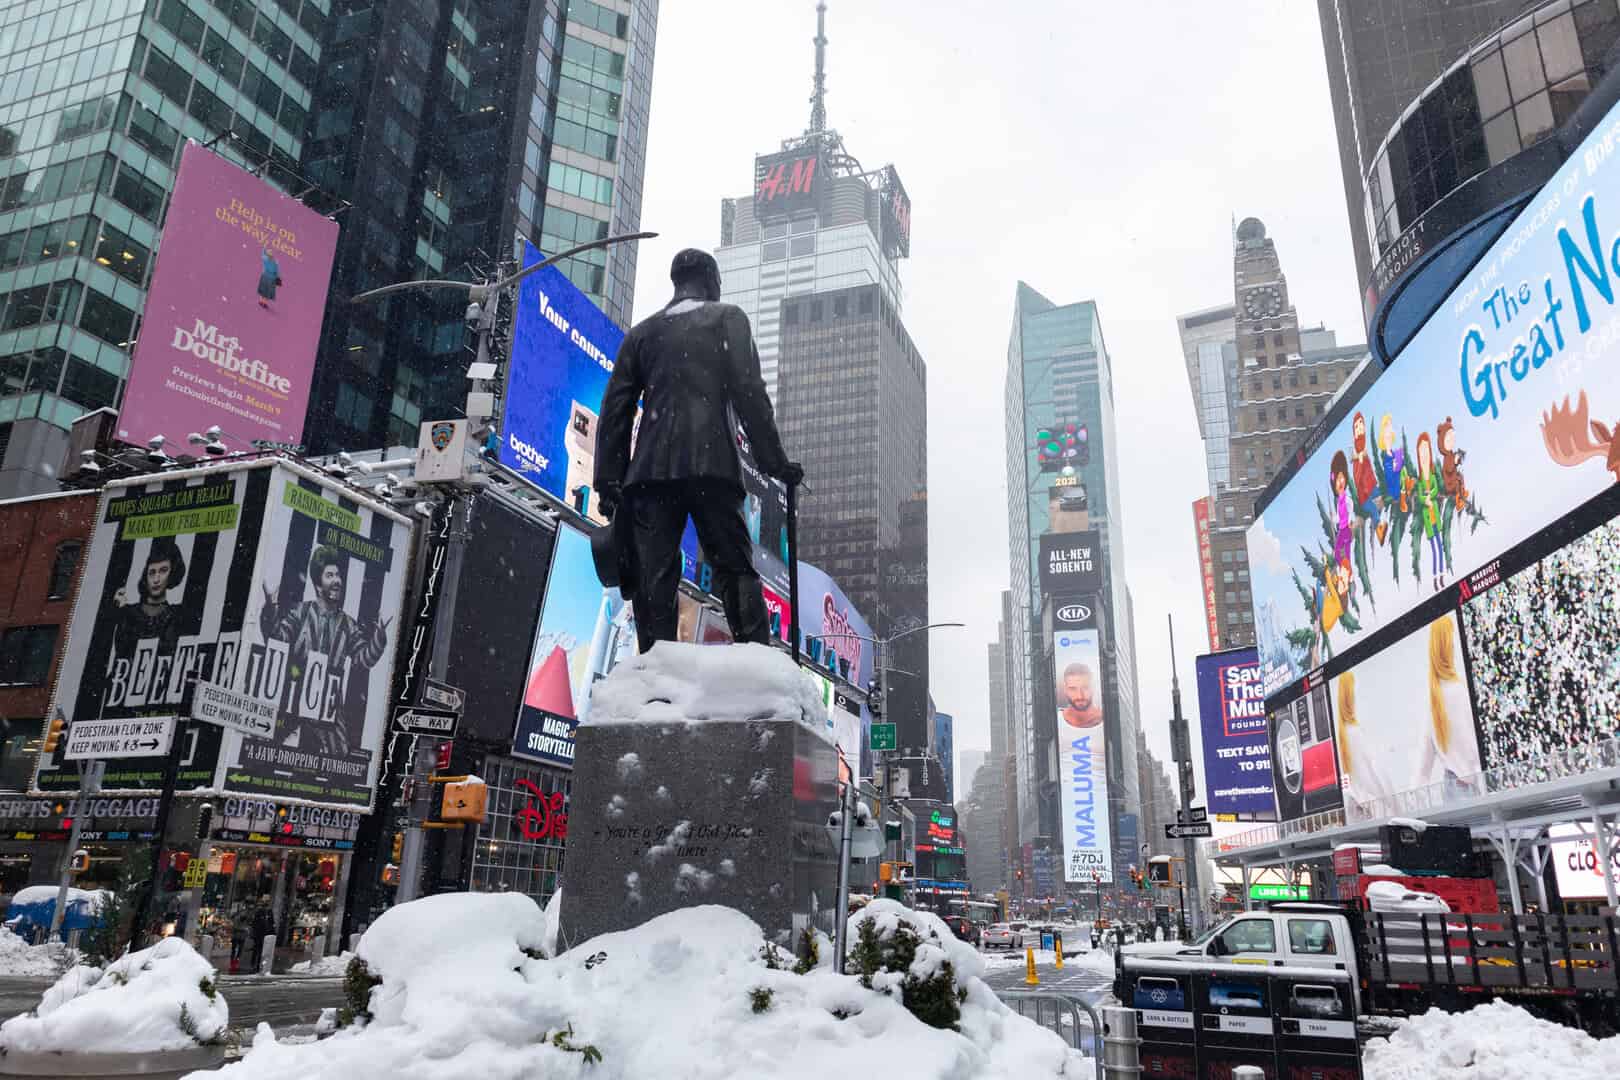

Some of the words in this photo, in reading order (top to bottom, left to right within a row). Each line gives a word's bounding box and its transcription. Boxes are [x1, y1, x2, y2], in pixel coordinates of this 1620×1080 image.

[757, 155, 816, 201] H&M
[216, 207, 238, 224] the
[231, 198, 263, 226] Help
[265, 216, 277, 232] is
[280, 228, 295, 243] on
[539, 289, 570, 334] Your
[1482, 275, 1531, 330] The
[192, 318, 243, 351] Mrs.
[1458, 268, 1566, 421] Great
[171, 327, 292, 394] Doubtfire
[172, 366, 216, 390] Previews
[510, 432, 549, 470] brother
[110, 500, 137, 517] TIMES
[139, 495, 172, 513] SQUARE
[176, 489, 195, 506] CAN
[196, 484, 233, 504] REALLY
[290, 488, 325, 516] RAISING
[127, 518, 154, 535] MAKE
[158, 516, 176, 532] YOU
[178, 513, 201, 529] FEEL
[327, 527, 337, 541] ON
[1050, 548, 1091, 561] ALL-NEW
[1049, 560, 1093, 574] SORENTO
[1471, 560, 1500, 583] MARRIOTT
[1472, 572, 1500, 592] MARQUIS
[1062, 607, 1086, 619] KIA
[1228, 682, 1264, 701] The
[202, 703, 218, 717] KEEP
[220, 709, 242, 725] MOVING
[204, 687, 241, 708] PEDESTRIAN
[242, 699, 258, 714] FLOW
[260, 704, 274, 719] ZONE
[74, 725, 120, 738] PEDESTRIAN
[121, 723, 141, 736] FLOW
[143, 722, 164, 735] ZONE
[402, 716, 421, 727] ONE
[428, 718, 449, 729] WAY
[542, 717, 570, 738] MAGIC
[70, 742, 90, 753] KEEP
[92, 741, 120, 752] MOVING
[255, 745, 319, 770] JAW-DROPPING
[1217, 747, 1243, 758] TEXT
[1238, 761, 1254, 771] TO
[1071, 735, 1097, 848] MALUMA
[224, 799, 276, 823] GIFTS
[288, 805, 361, 830] LUGGAGE
[305, 838, 333, 848] SONY
[1071, 853, 1104, 864] #7DJ
